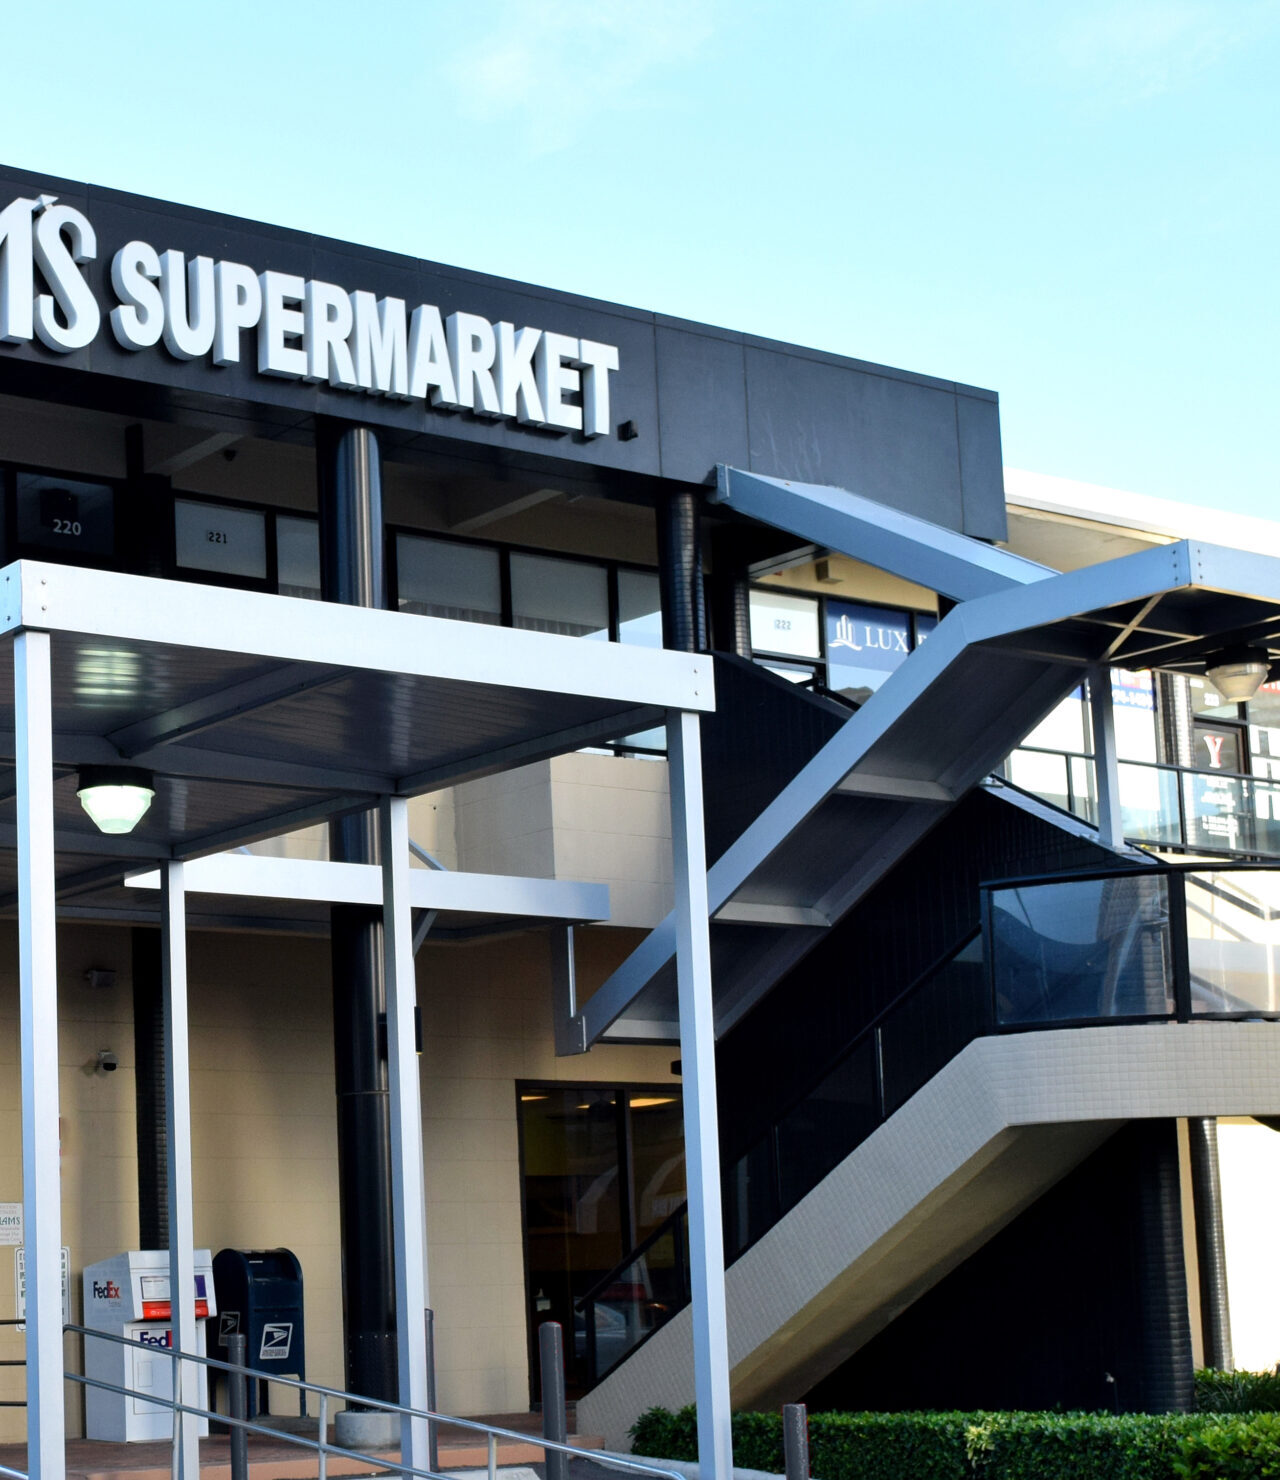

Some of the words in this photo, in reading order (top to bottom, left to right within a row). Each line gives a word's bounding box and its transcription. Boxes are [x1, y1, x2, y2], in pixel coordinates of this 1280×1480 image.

[111, 240, 620, 439] SUPERMARKET
[52, 518, 82, 537] 220
[207, 531, 228, 545] 221
[775, 619, 792, 631] 222
[93, 1280, 120, 1299] FedEx
[139, 1330, 173, 1347] Fed
